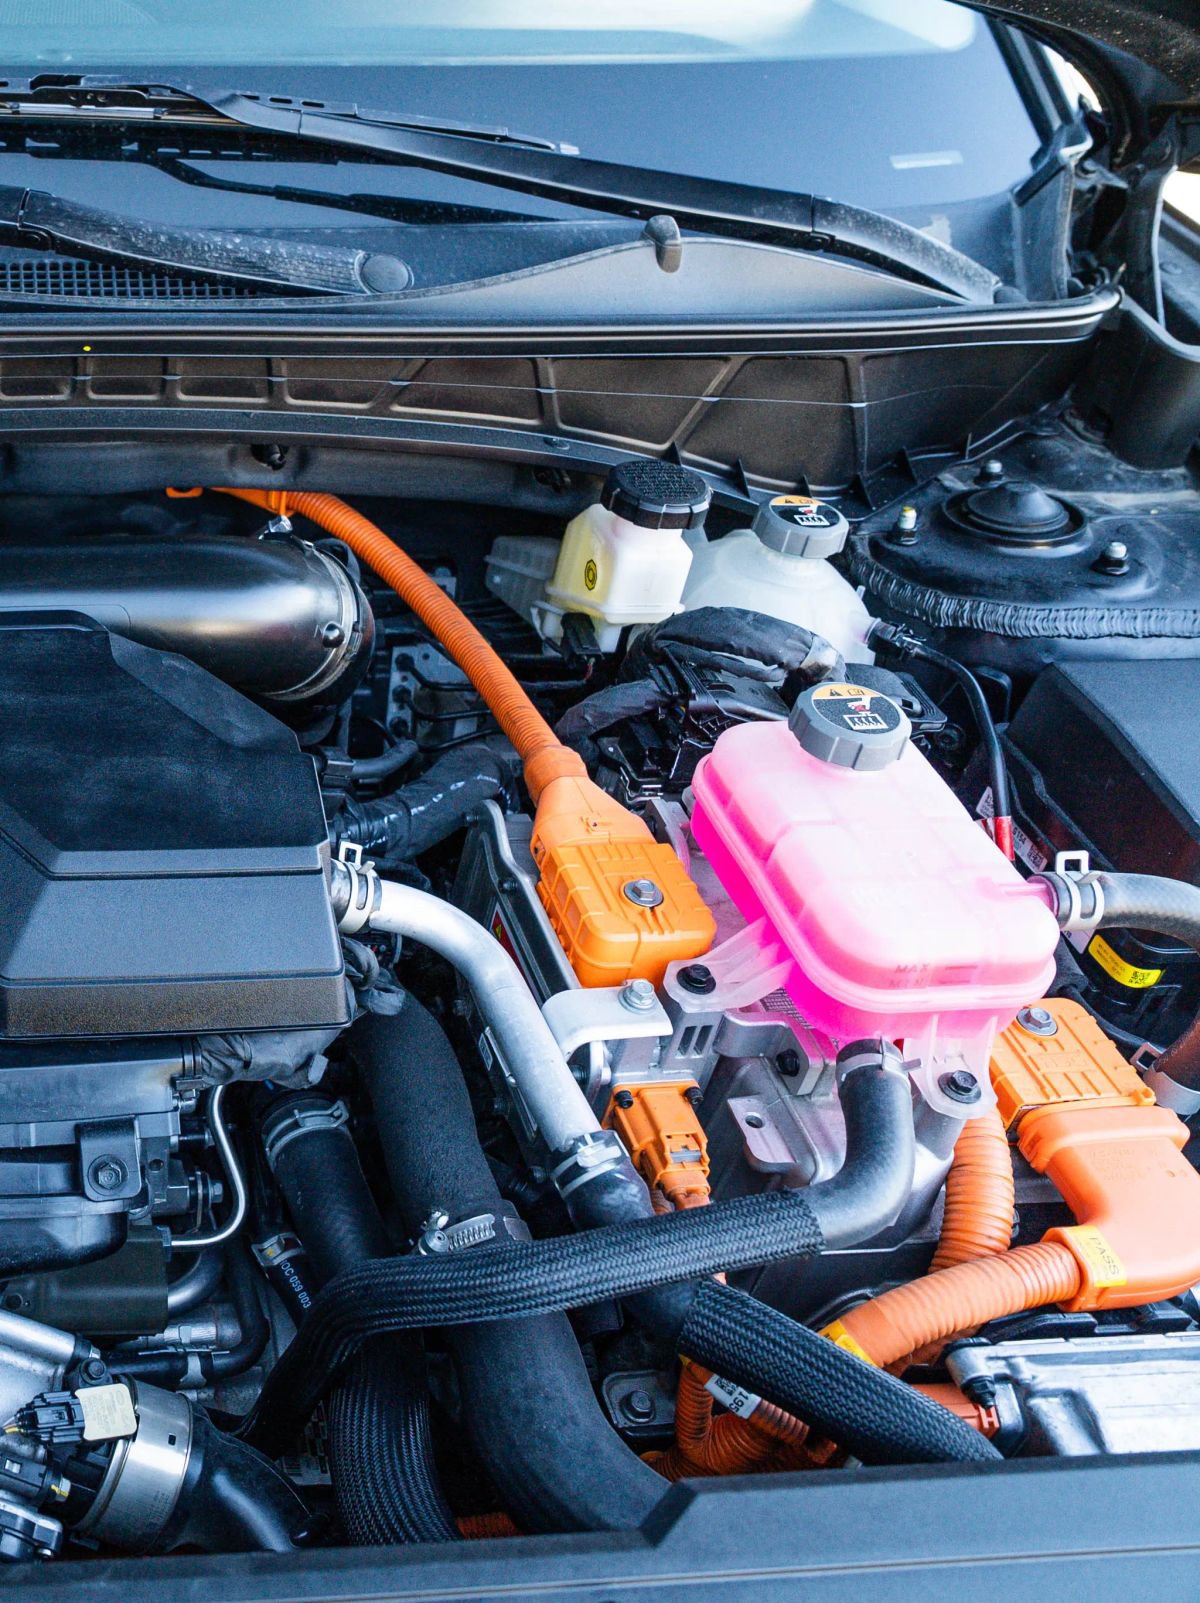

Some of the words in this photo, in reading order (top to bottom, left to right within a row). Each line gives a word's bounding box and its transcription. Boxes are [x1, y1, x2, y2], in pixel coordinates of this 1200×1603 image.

[894, 963, 930, 973] MAX
[1087, 1236, 1120, 1276] PASS
[289, 1275, 304, 1292] 059
[298, 1291, 312, 1309] 003
[728, 1391, 748, 1413] 195
